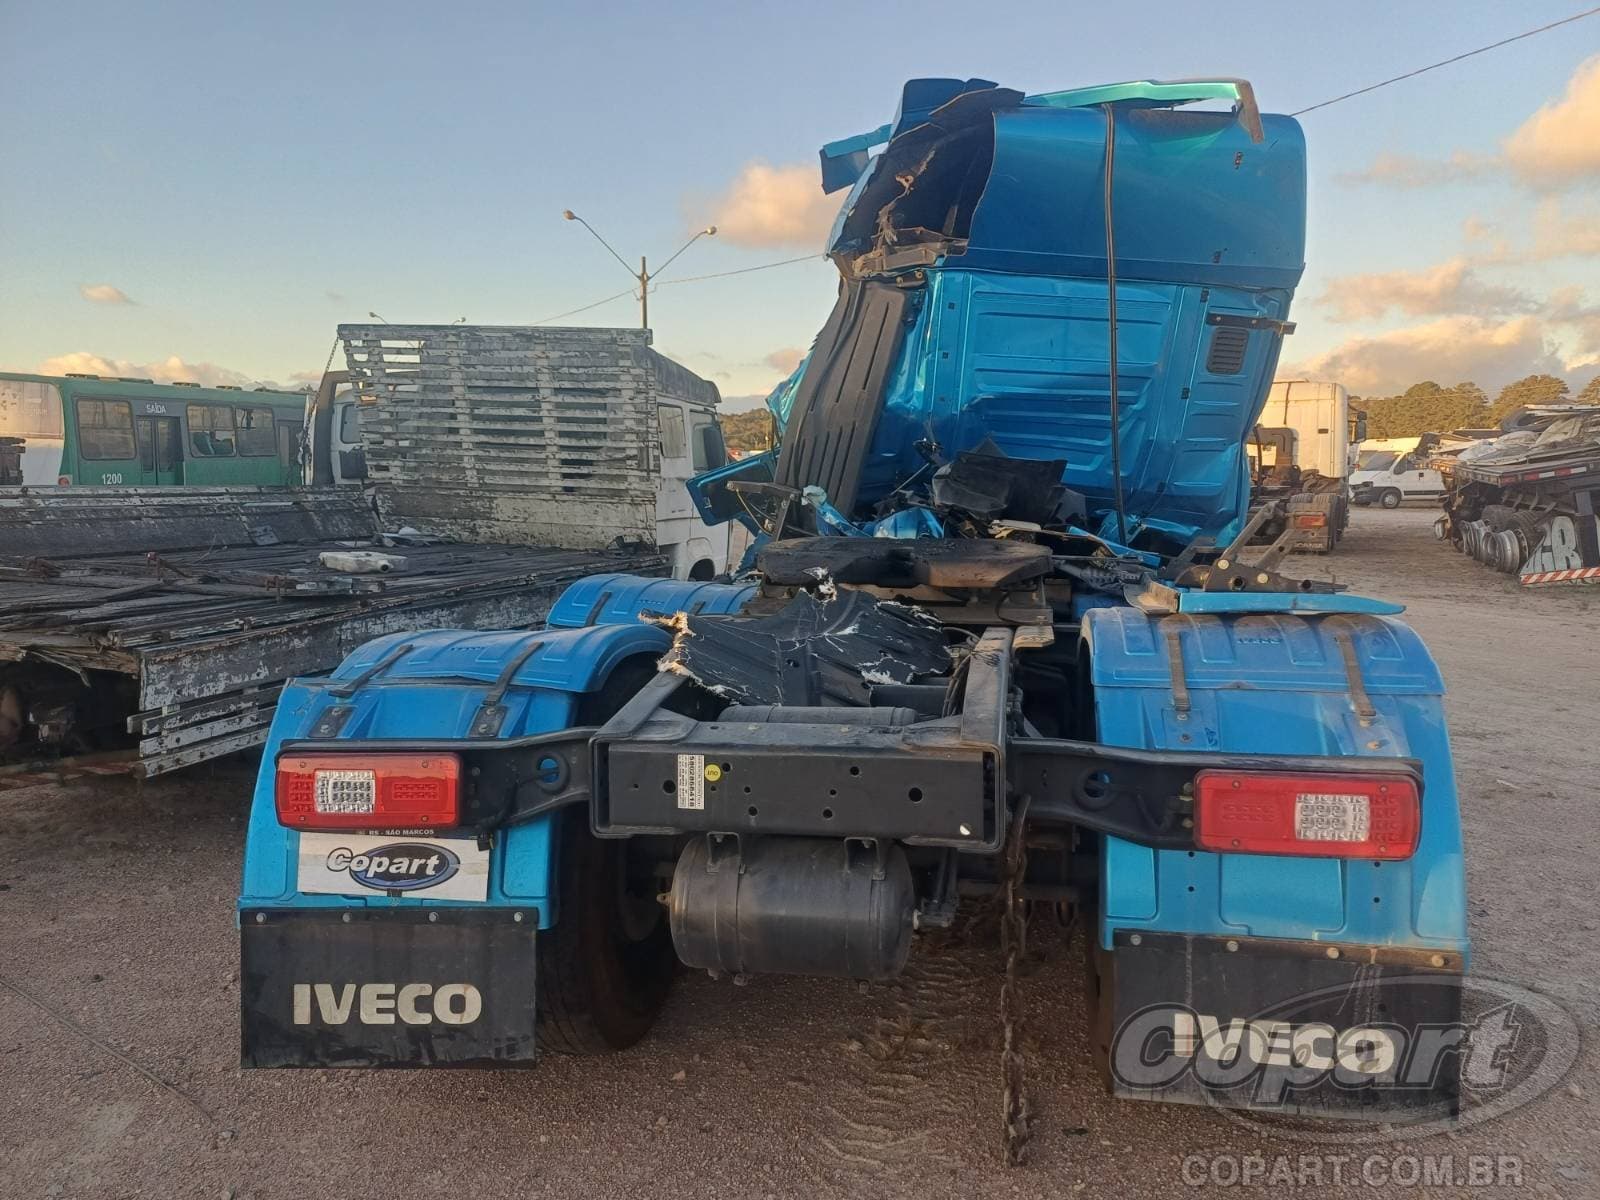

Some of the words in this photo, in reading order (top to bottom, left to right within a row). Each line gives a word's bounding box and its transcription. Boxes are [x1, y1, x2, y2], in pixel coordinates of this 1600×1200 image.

[101, 473, 123, 485] 1200
[327, 847, 439, 877] Copart
[293, 983, 482, 1025] IVECO
[1174, 1013, 1396, 1074] IVECO
